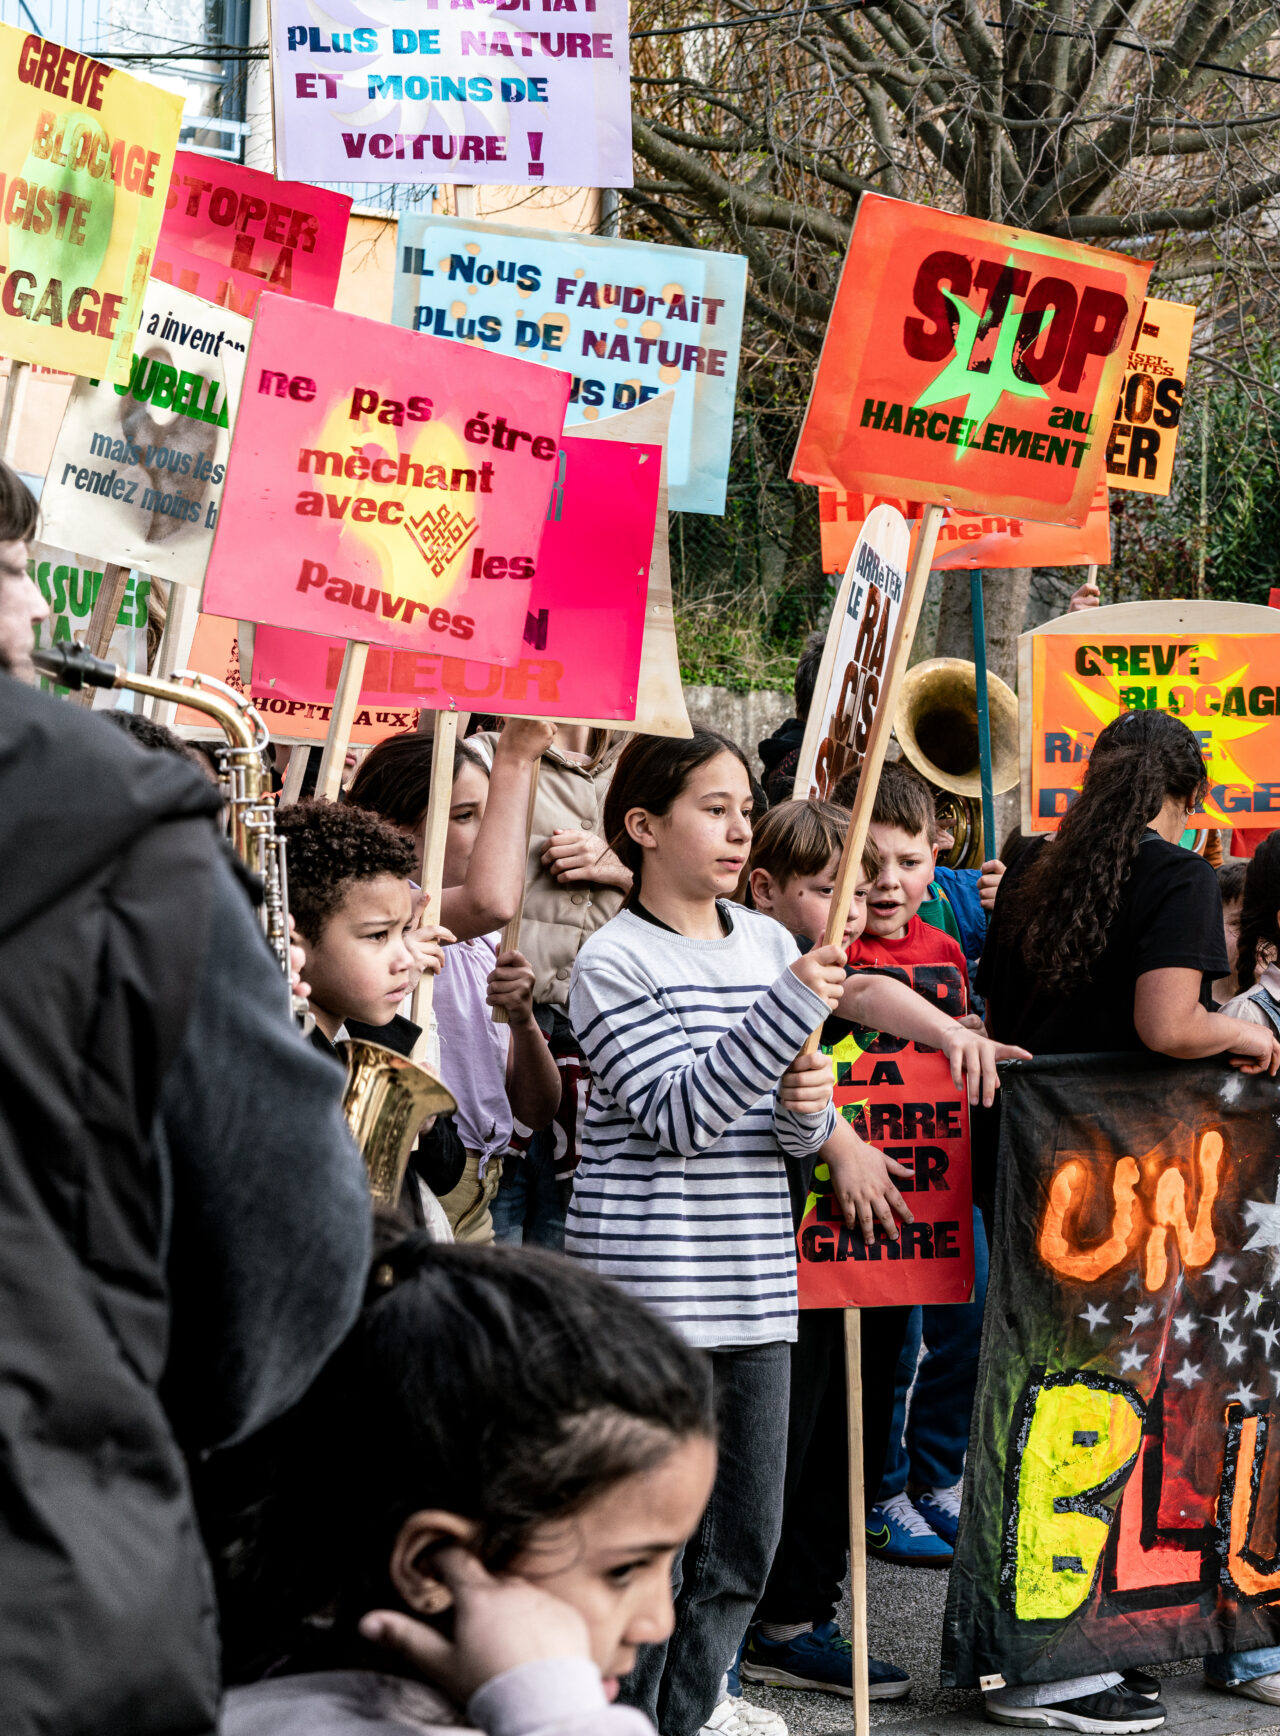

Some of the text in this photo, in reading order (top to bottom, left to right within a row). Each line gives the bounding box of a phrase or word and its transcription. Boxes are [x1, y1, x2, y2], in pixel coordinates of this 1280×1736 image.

[392, 28, 441, 55] DE
[460, 30, 614, 58] NATURE
[18, 34, 112, 111] GREVE
[295, 73, 343, 99] ET
[501, 77, 549, 102] DE
[32, 110, 161, 198] BLOCAGE
[341, 131, 545, 177] VOITURE !
[0, 172, 92, 246] CISTE
[231, 233, 294, 292] LA
[402, 246, 434, 276] IL
[0, 265, 128, 340] GAGE
[147, 312, 160, 335] a
[903, 250, 1129, 394] STOP
[515, 319, 564, 353] DE
[581, 329, 728, 377] NATURE
[88, 353, 230, 428] OUBELL
[257, 368, 317, 403] ne
[349, 387, 434, 428] pas
[859, 398, 1092, 469] HARCELEMENT
[1047, 405, 1099, 436] au
[90, 432, 225, 484] mais vous les
[1106, 422, 1161, 480] ER
[61, 463, 138, 504] rendez
[141, 487, 201, 523] moins
[294, 489, 405, 527] avec
[470, 547, 536, 580] les
[27, 559, 151, 628] SSUES
[295, 557, 476, 641] pauvres
[847, 581, 863, 620] LE
[854, 582, 892, 677] RA
[1075, 644, 1200, 677] GREVE
[250, 698, 412, 728] HOPITAuX
[834, 660, 880, 755] CIS
[837, 1060, 905, 1086] LA
[1039, 1129, 1223, 1292] UN
[797, 1220, 960, 1264] GARRE
